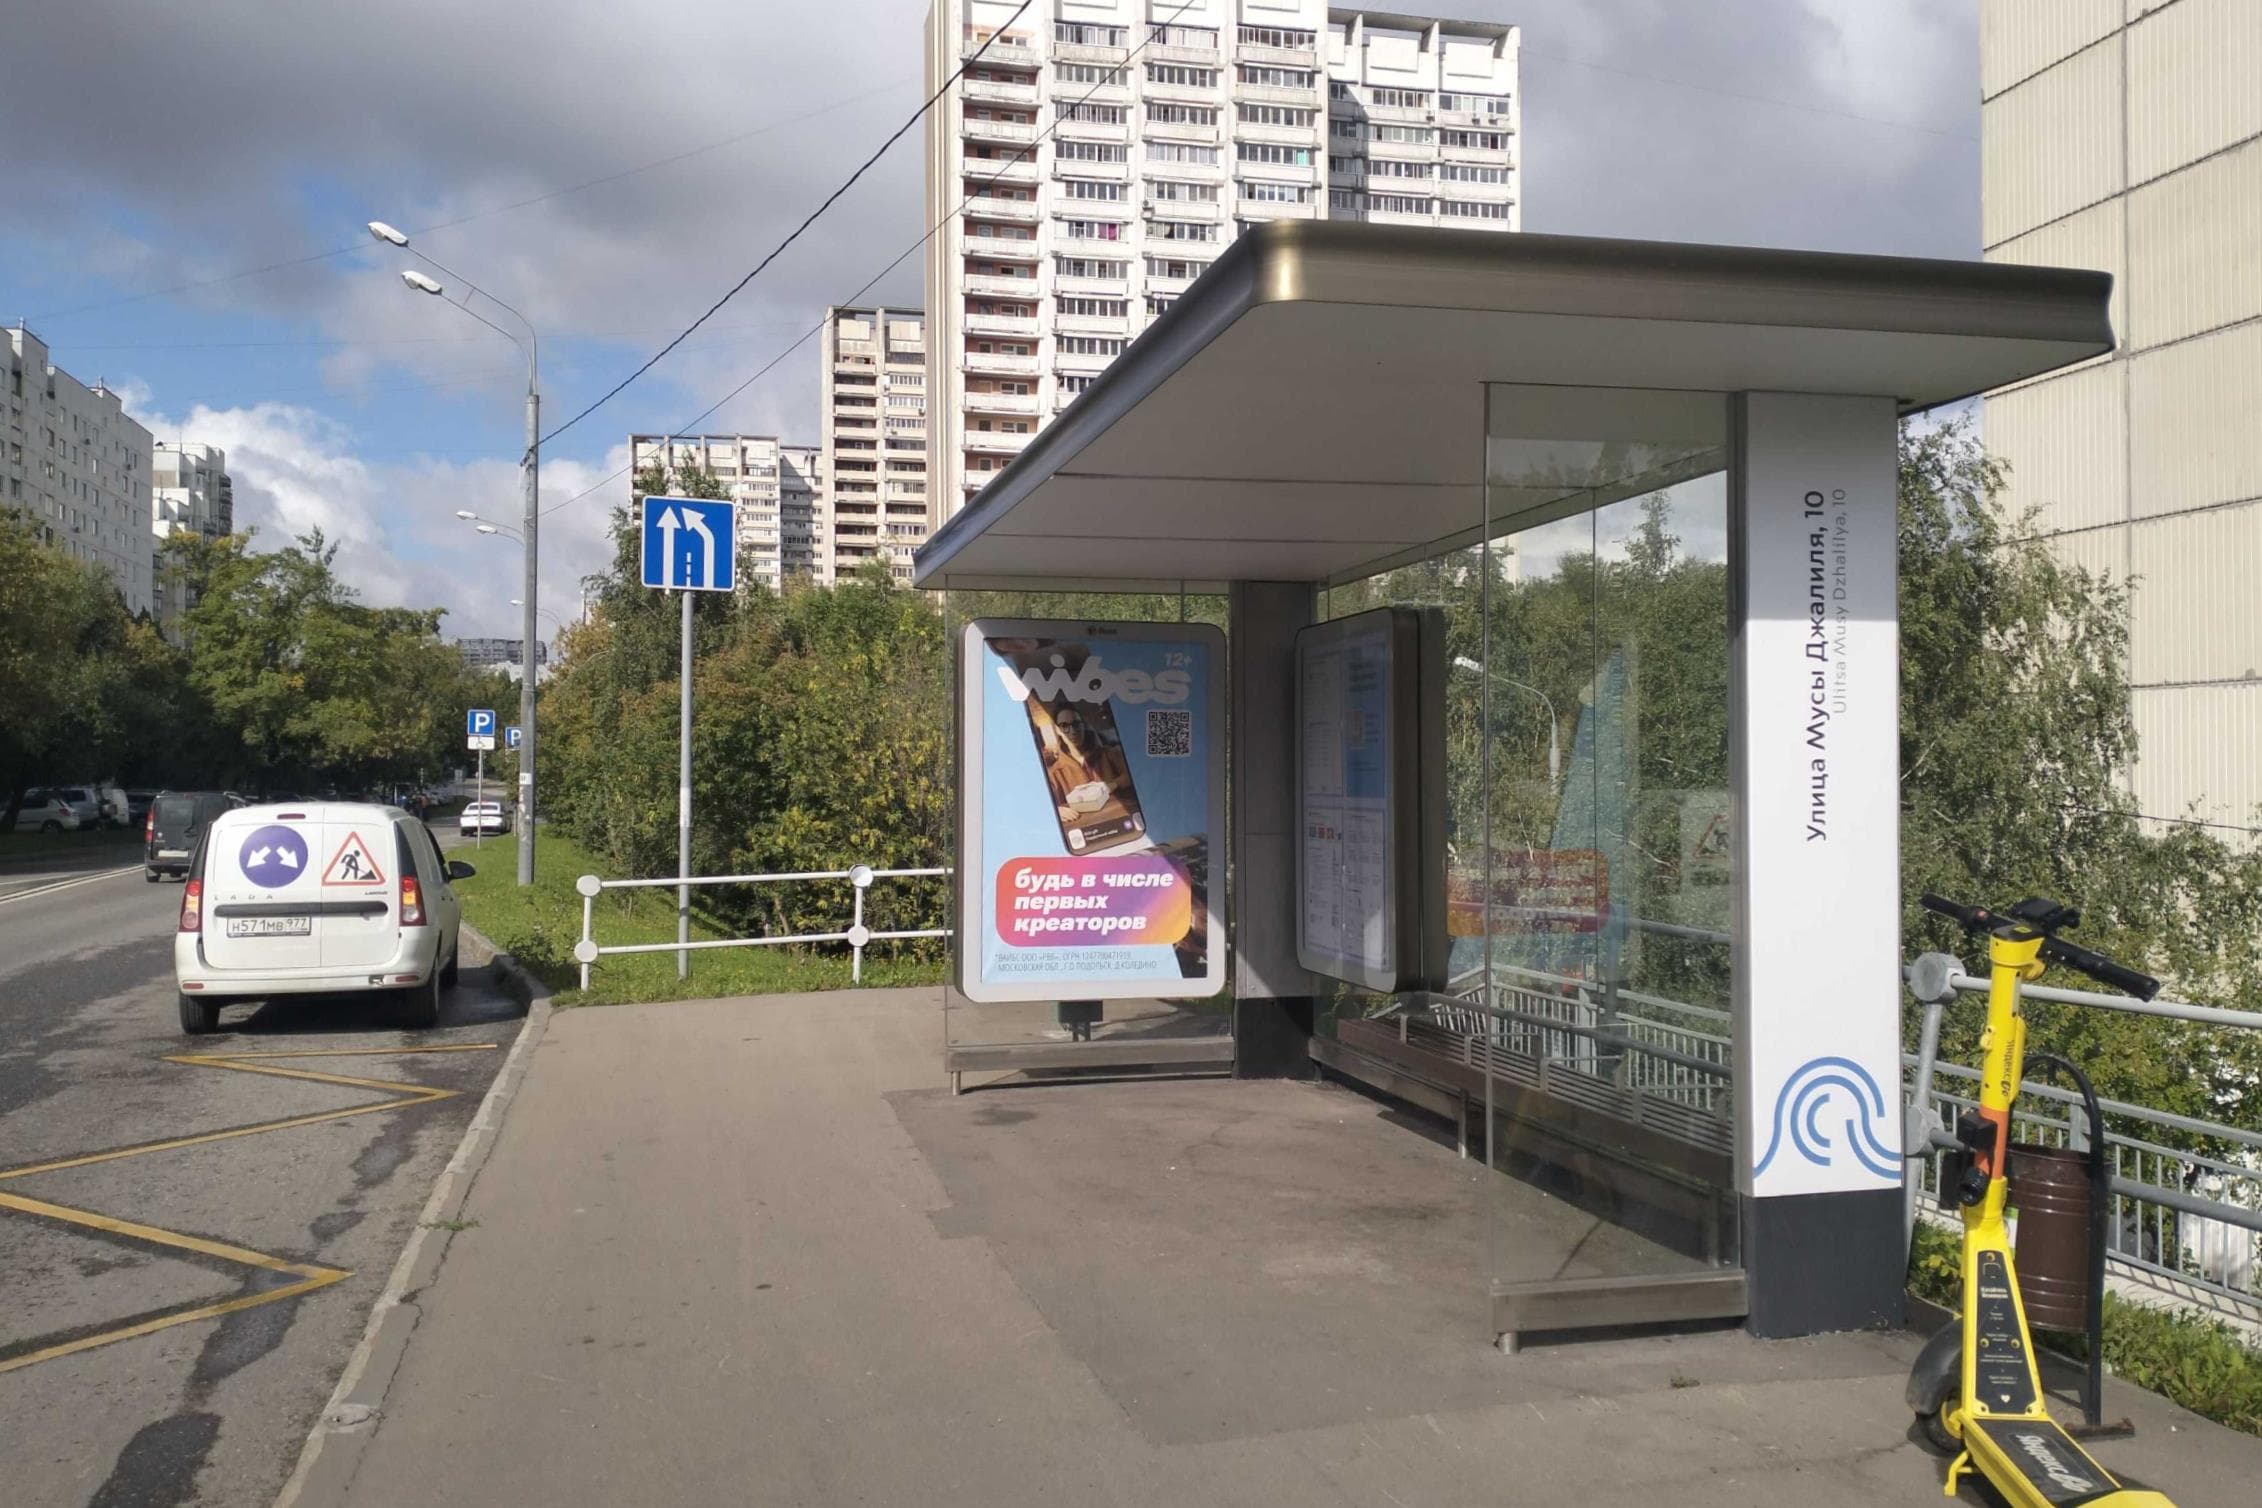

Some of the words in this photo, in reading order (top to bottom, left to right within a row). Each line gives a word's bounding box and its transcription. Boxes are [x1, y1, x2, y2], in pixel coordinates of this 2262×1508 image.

[1804, 490, 1824, 519] 10
[1832, 488, 1846, 508] 10
[1805, 525, 1829, 662] Джалиля,
[1833, 605, 1850, 655] Musy
[1164, 652, 1193, 667] 12+
[1832, 661, 1847, 714] Ulitsa
[475, 712, 490, 733] P
[1806, 670, 1830, 750] Мусы
[1806, 758, 1828, 841] Улица
[1014, 867, 1075, 893] будь
[1081, 874, 1096, 888] в
[1102, 872, 1174, 888] числе
[1014, 895, 1109, 914] первых
[1014, 915, 1147, 936] креаторов
